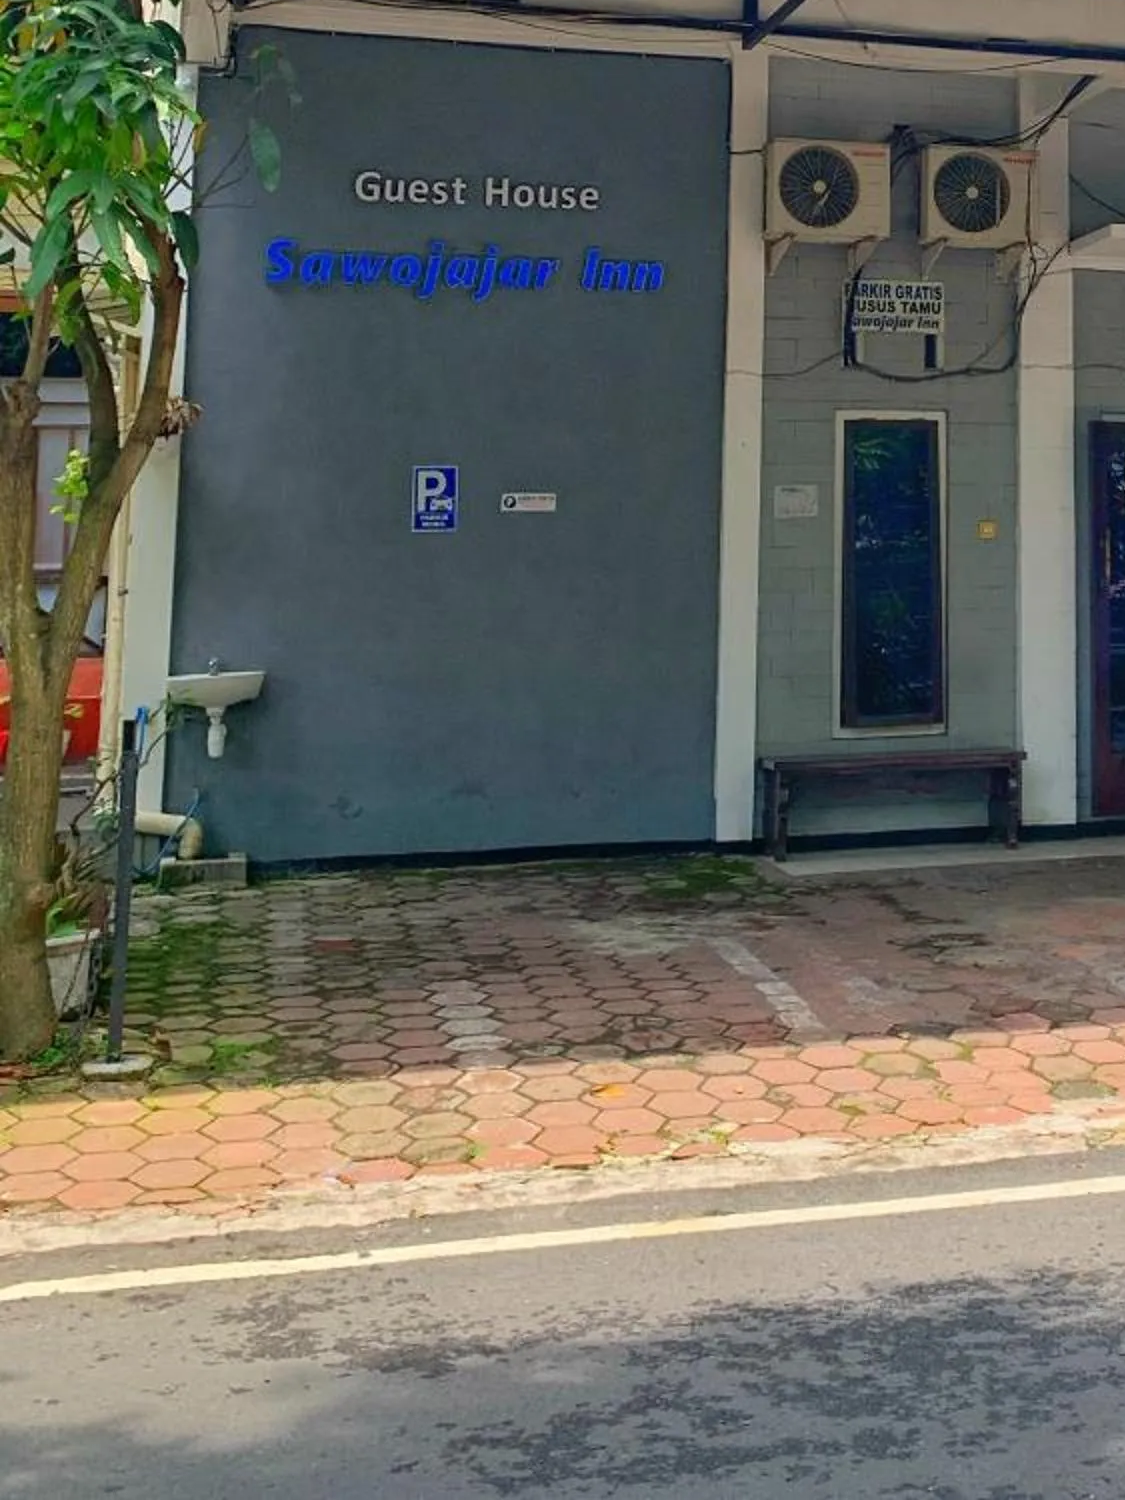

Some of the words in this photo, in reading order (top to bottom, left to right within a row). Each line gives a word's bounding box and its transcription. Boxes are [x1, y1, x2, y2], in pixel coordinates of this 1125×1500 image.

[355, 171, 467, 205] Guest
[485, 177, 600, 209] House
[265, 236, 561, 301] Sawojajar
[580, 245, 664, 292] Inn
[895, 284, 943, 301] GRATIS
[900, 301, 941, 315] TAMU
[917, 316, 940, 330] Inn
[418, 470, 447, 512] P
